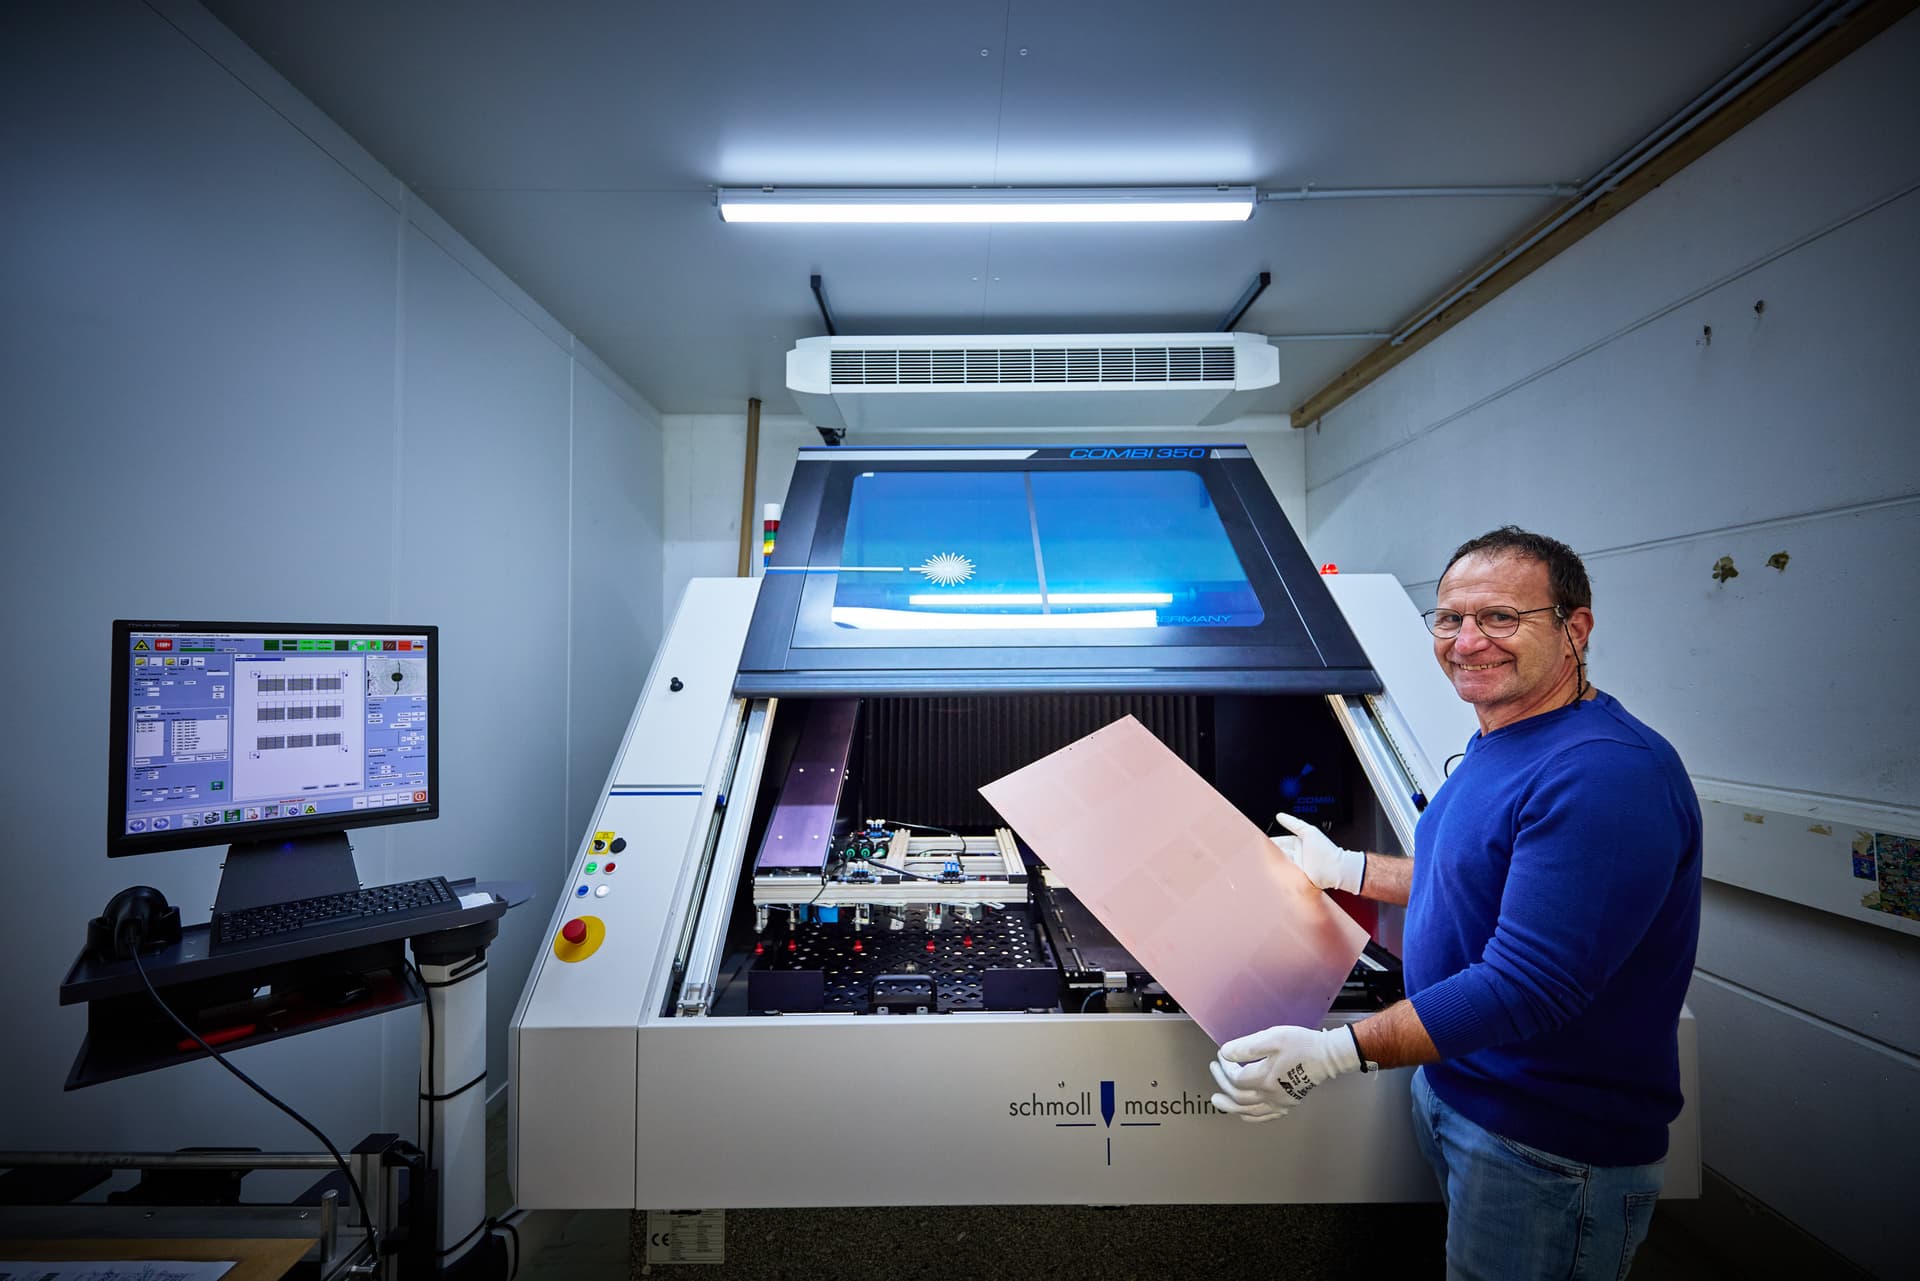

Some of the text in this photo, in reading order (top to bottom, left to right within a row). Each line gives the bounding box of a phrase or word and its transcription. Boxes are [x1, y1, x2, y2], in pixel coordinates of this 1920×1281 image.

[1069, 448, 1205, 459] COMBI 350
[1009, 1092, 1091, 1116] schmoll
